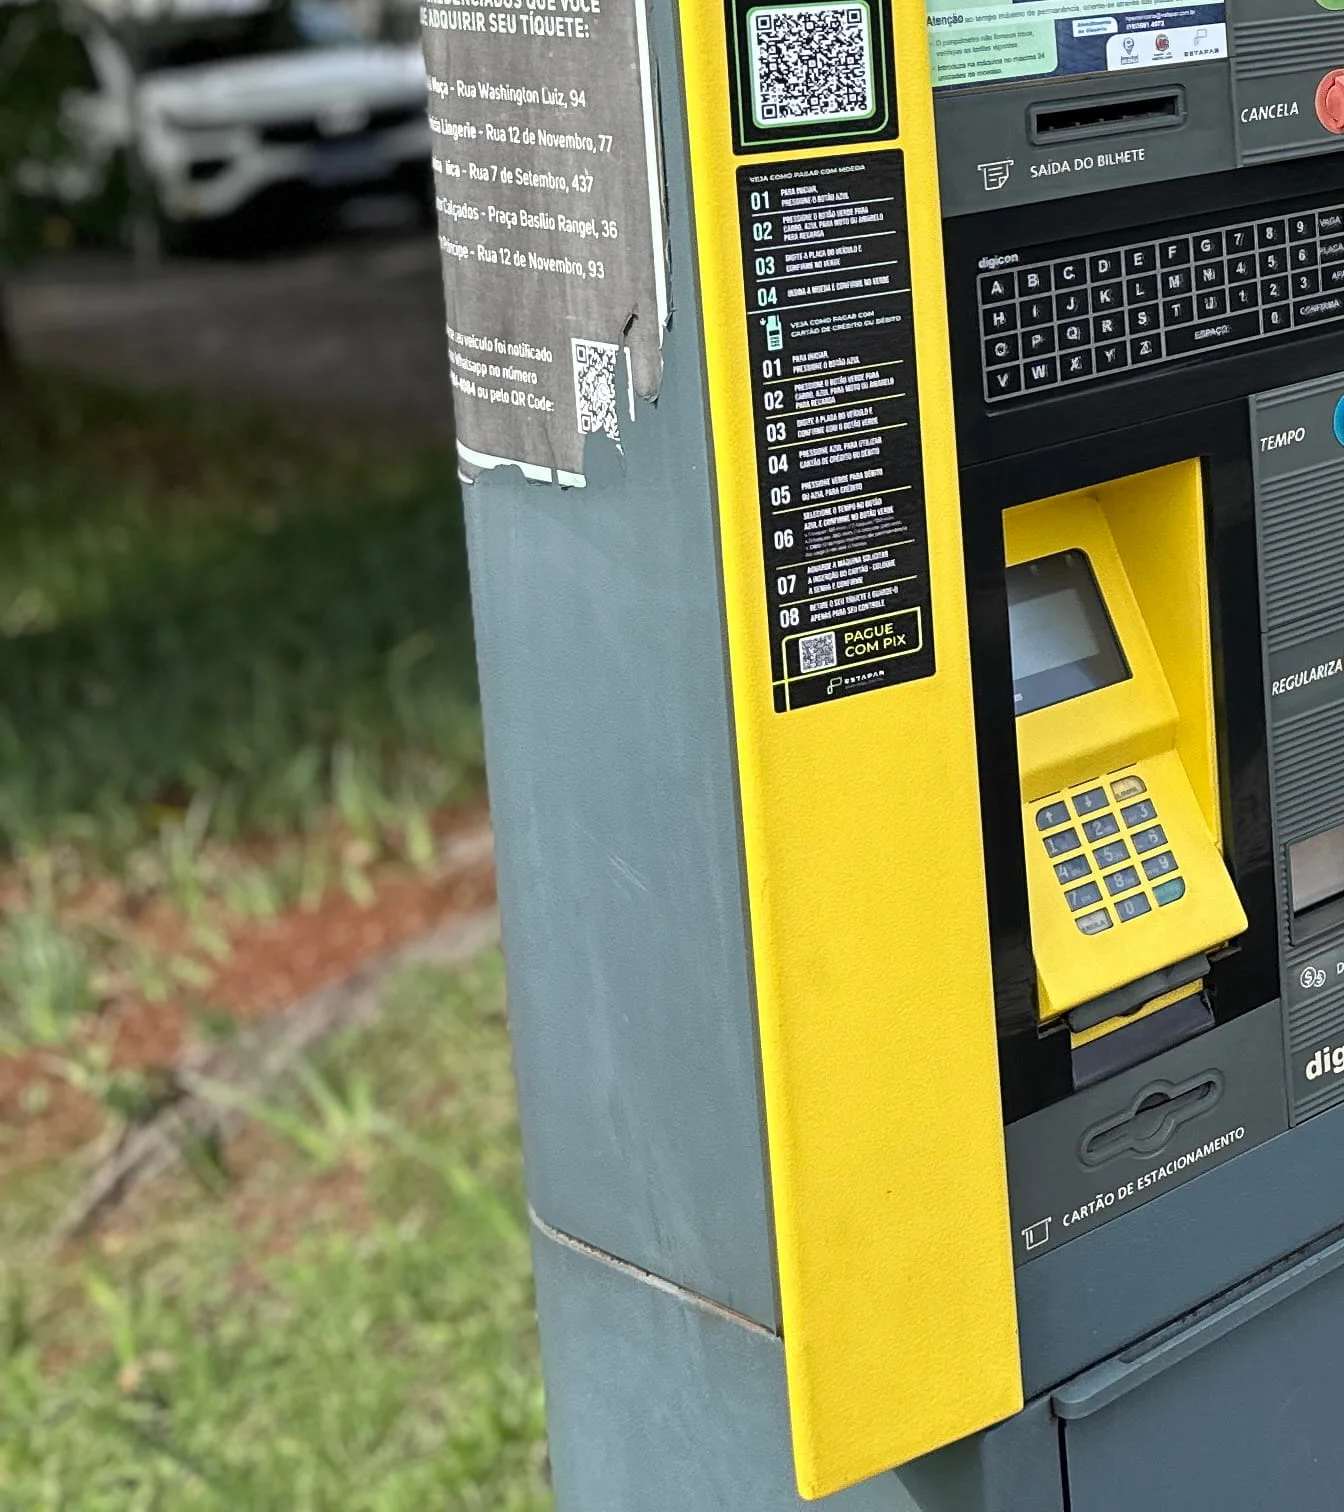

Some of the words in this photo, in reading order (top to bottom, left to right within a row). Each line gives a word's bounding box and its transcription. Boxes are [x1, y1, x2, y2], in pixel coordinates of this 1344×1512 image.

[429, 11, 486, 32] ADQUIRIR
[490, 14, 516, 34] SEU
[520, 12, 590, 38] TÍQUETE:
[927, 13, 964, 28] Atenção
[457, 80, 477, 98] Rua
[477, 82, 539, 106] Washington
[542, 87, 567, 109] Luiz,
[570, 90, 585, 107] 94
[1241, 101, 1299, 123] CANCELA
[441, 118, 477, 139] Lingerie
[487, 124, 506, 142] Rua
[509, 127, 520, 144] 12
[523, 128, 535, 145] de
[538, 130, 596, 153] Novembro,
[598, 135, 613, 152] 77
[1030, 159, 1070, 178] SAÍDA
[1075, 157, 1093, 171] DO
[1098, 148, 1145, 167] BILHETE
[469, 163, 489, 182] Rua
[491, 166, 497, 182] 7
[501, 167, 513, 184] de
[516, 168, 569, 193] Setembro,
[572, 175, 593, 193] 437
[751, 191, 770, 211] 01
[442, 198, 479, 221] Calçados
[488, 206, 517, 229] Praça
[559, 214, 599, 239] Rangel,
[602, 220, 619, 238] 36
[1296, 221, 1305, 233] 9
[753, 221, 773, 241] 02
[1265, 227, 1274, 239] 8
[1168, 246, 1177, 259] F
[1200, 240, 1212, 252] G
[1298, 248, 1307, 261] 6
[477, 245, 497, 263] Rua
[500, 248, 511, 264] 12
[514, 250, 526, 267] de
[529, 251, 586, 279] Novembro,
[588, 262, 605, 279] 93
[755, 256, 775, 276] 03
[977, 252, 1019, 270] digicon
[1098, 260, 1110, 273] D
[1134, 253, 1143, 266] E
[1267, 255, 1276, 268] 5
[1027, 274, 1040, 287] B
[1063, 266, 1074, 280] C
[1169, 275, 1181, 289] M
[1300, 276, 1309, 289] 3
[757, 287, 778, 306] 04
[991, 281, 1002, 295] A
[1100, 289, 1112, 303] K
[1136, 283, 1145, 296] L
[1269, 283, 1278, 296] 2
[1102, 319, 1113, 333] R
[1138, 311, 1147, 324] S
[494, 337, 506, 354] foi
[508, 342, 553, 363] notificado
[489, 365, 500, 378] no
[502, 365, 537, 385] número
[763, 358, 782, 378] 01
[478, 385, 488, 398] ou
[490, 387, 509, 404] pelo
[511, 391, 525, 407] QR
[527, 393, 554, 412] Code:
[764, 390, 784, 410] 02
[767, 423, 786, 442] 03
[1260, 428, 1305, 452] TEMPO
[768, 454, 788, 474] 04
[771, 486, 791, 506] 05
[774, 530, 794, 549] 06
[777, 574, 796, 595] 07
[780, 608, 800, 628] 08
[844, 623, 894, 644] PAGUE
[845, 640, 881, 658] COM
[883, 634, 907, 652] PIX
[1272, 658, 1343, 696] REGULARIZA
[1063, 1192, 1114, 1227] CARTÃO
[1118, 1182, 1133, 1200] DE
[1137, 1126, 1245, 1190] ESTACIONAMENTO
